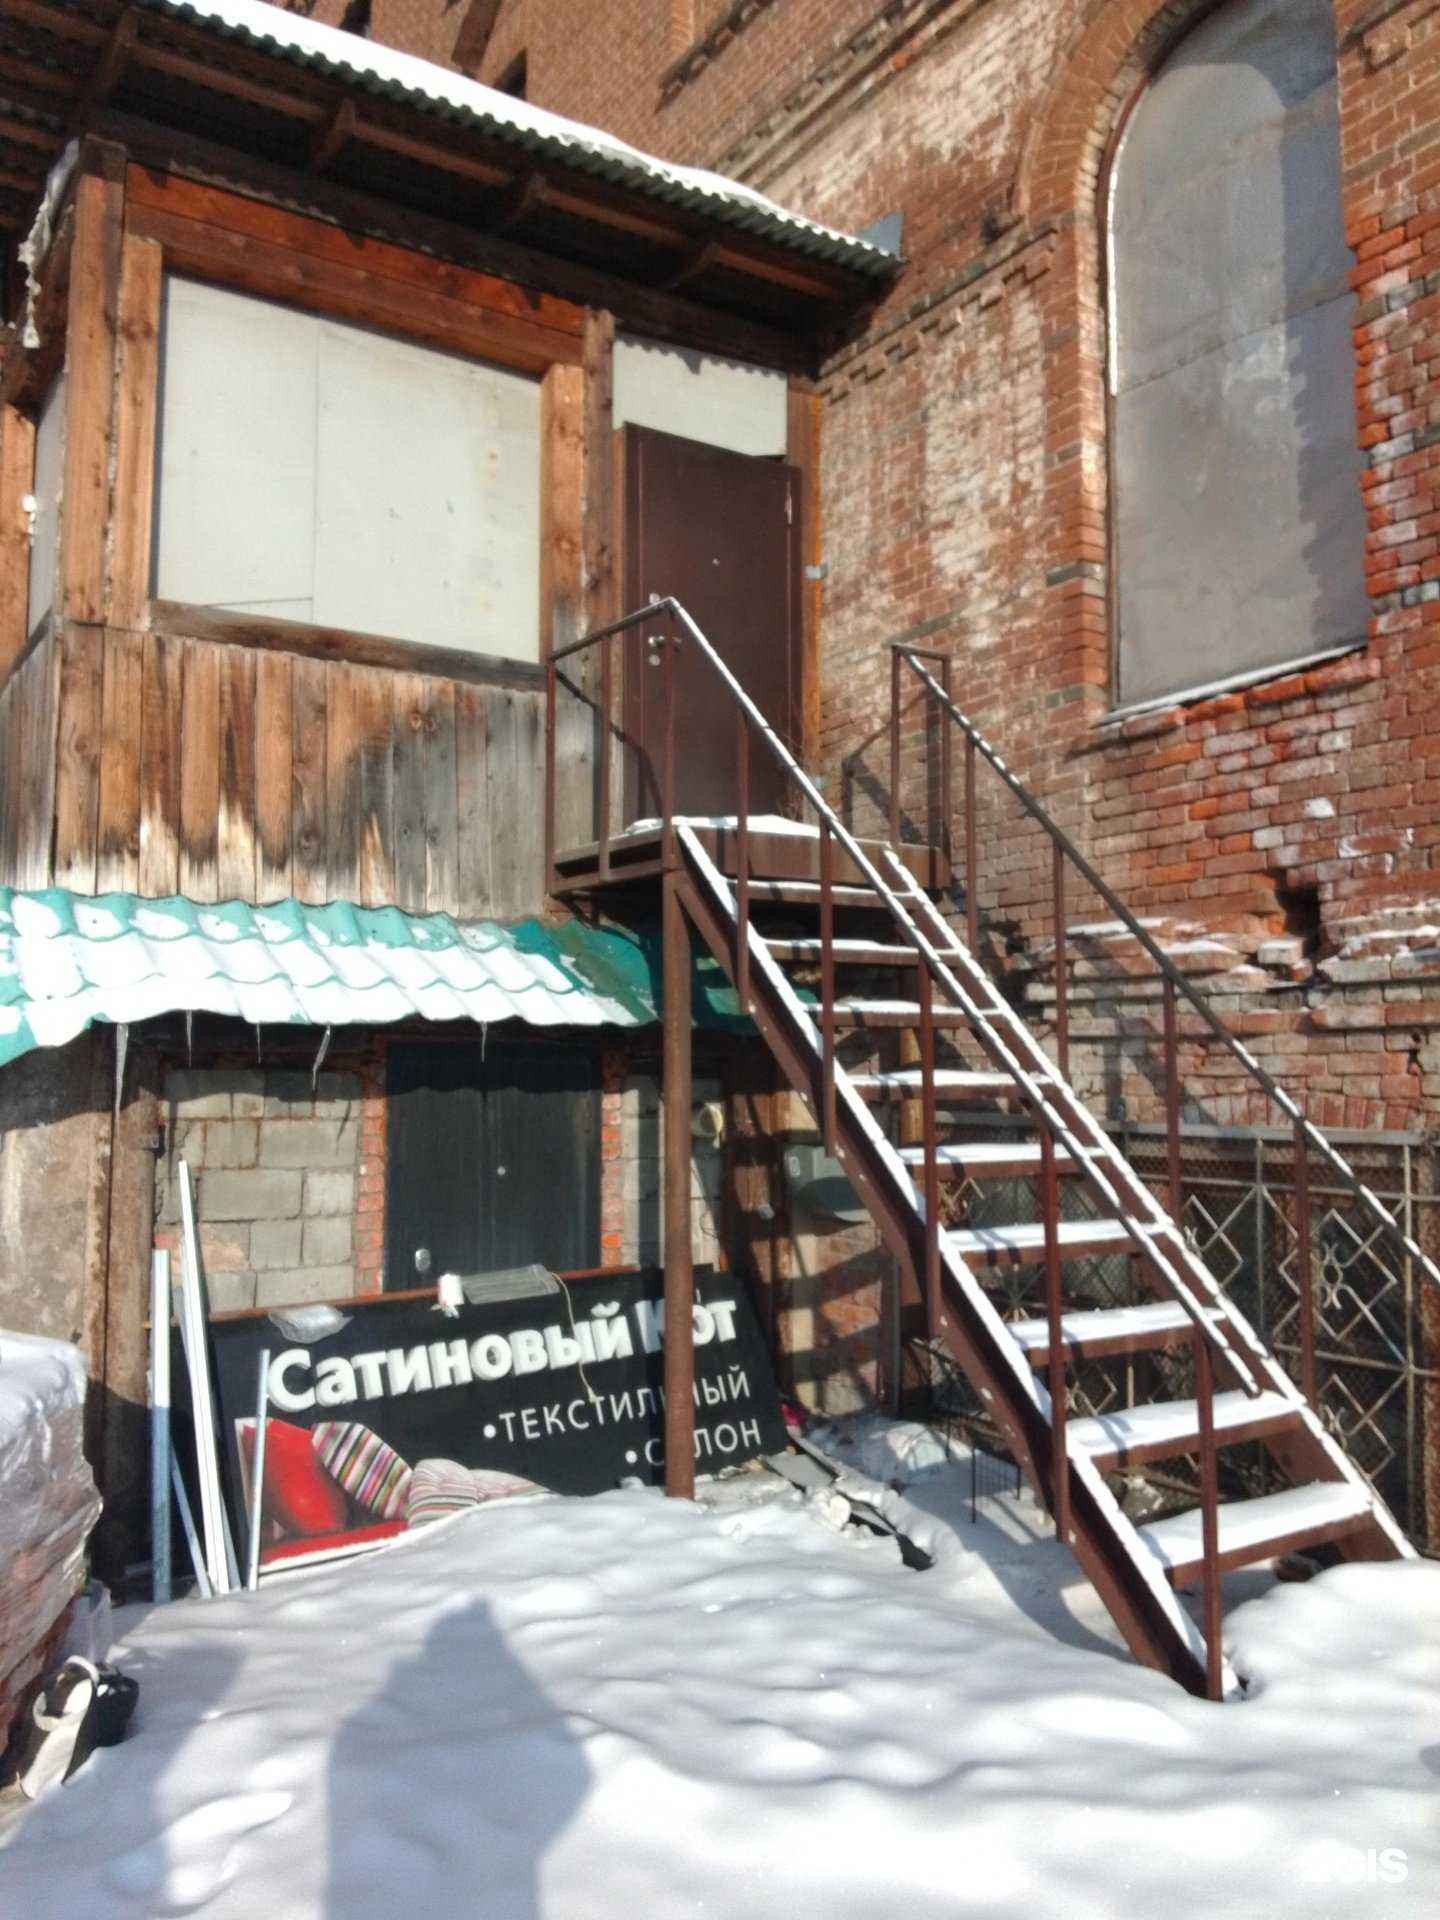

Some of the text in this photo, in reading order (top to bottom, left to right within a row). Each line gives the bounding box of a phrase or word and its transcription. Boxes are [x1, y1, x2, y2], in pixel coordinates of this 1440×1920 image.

[266, 1302, 634, 1413] Сатиновый
[499, 1365, 750, 1443] ТЕКСТИЛЫЙ
[644, 1419, 762, 1466] СЛОН
